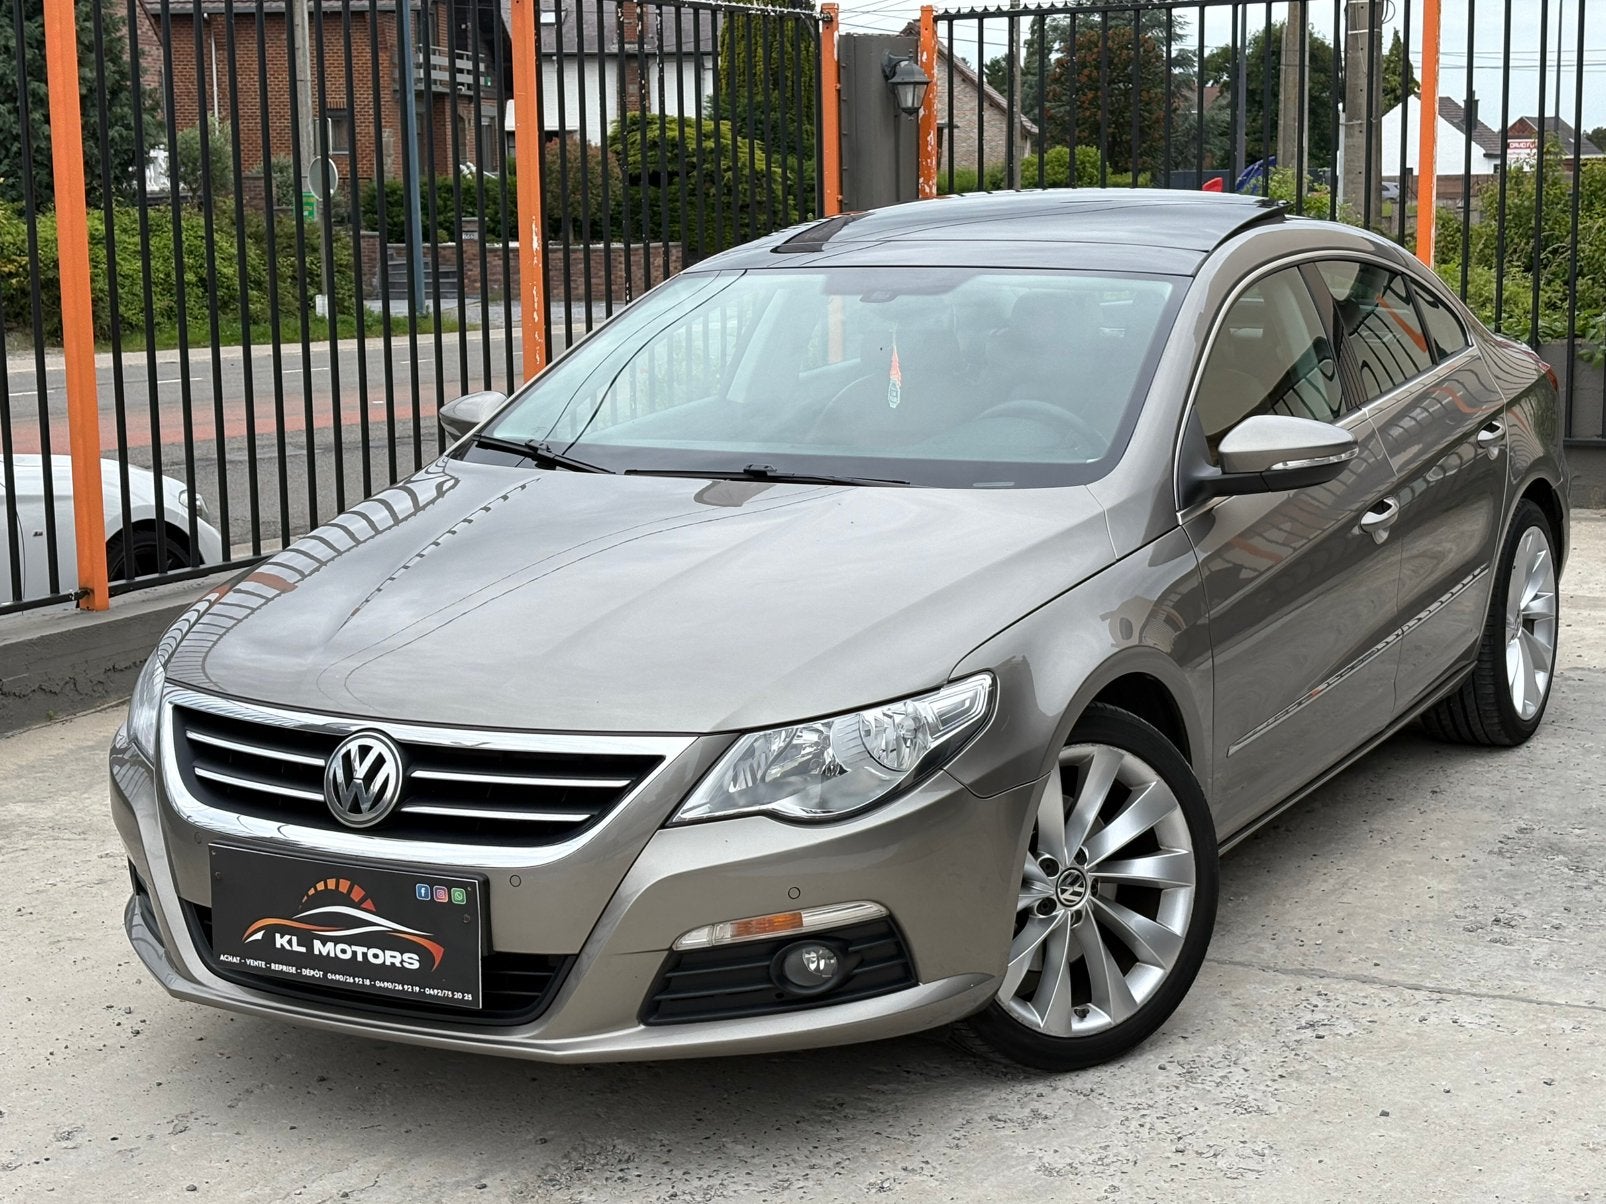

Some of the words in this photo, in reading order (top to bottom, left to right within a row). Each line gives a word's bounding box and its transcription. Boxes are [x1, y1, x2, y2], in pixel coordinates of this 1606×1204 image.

[274, 932, 307, 953] KL
[313, 938, 420, 970] MOTORS
[219, 954, 240, 963] ACHAT
[245, 958, 266, 968] VENTE
[270, 963, 297, 974] REPRISE
[301, 968, 323, 978] DÉPÔT
[327, 973, 354, 983] 0490/26
[354, 977, 363, 985] 92
[375, 980, 403, 991] 0490/26
[403, 984, 412, 992] 92
[424, 987, 453, 998] 0492/75
[463, 993, 473, 1001] 25
